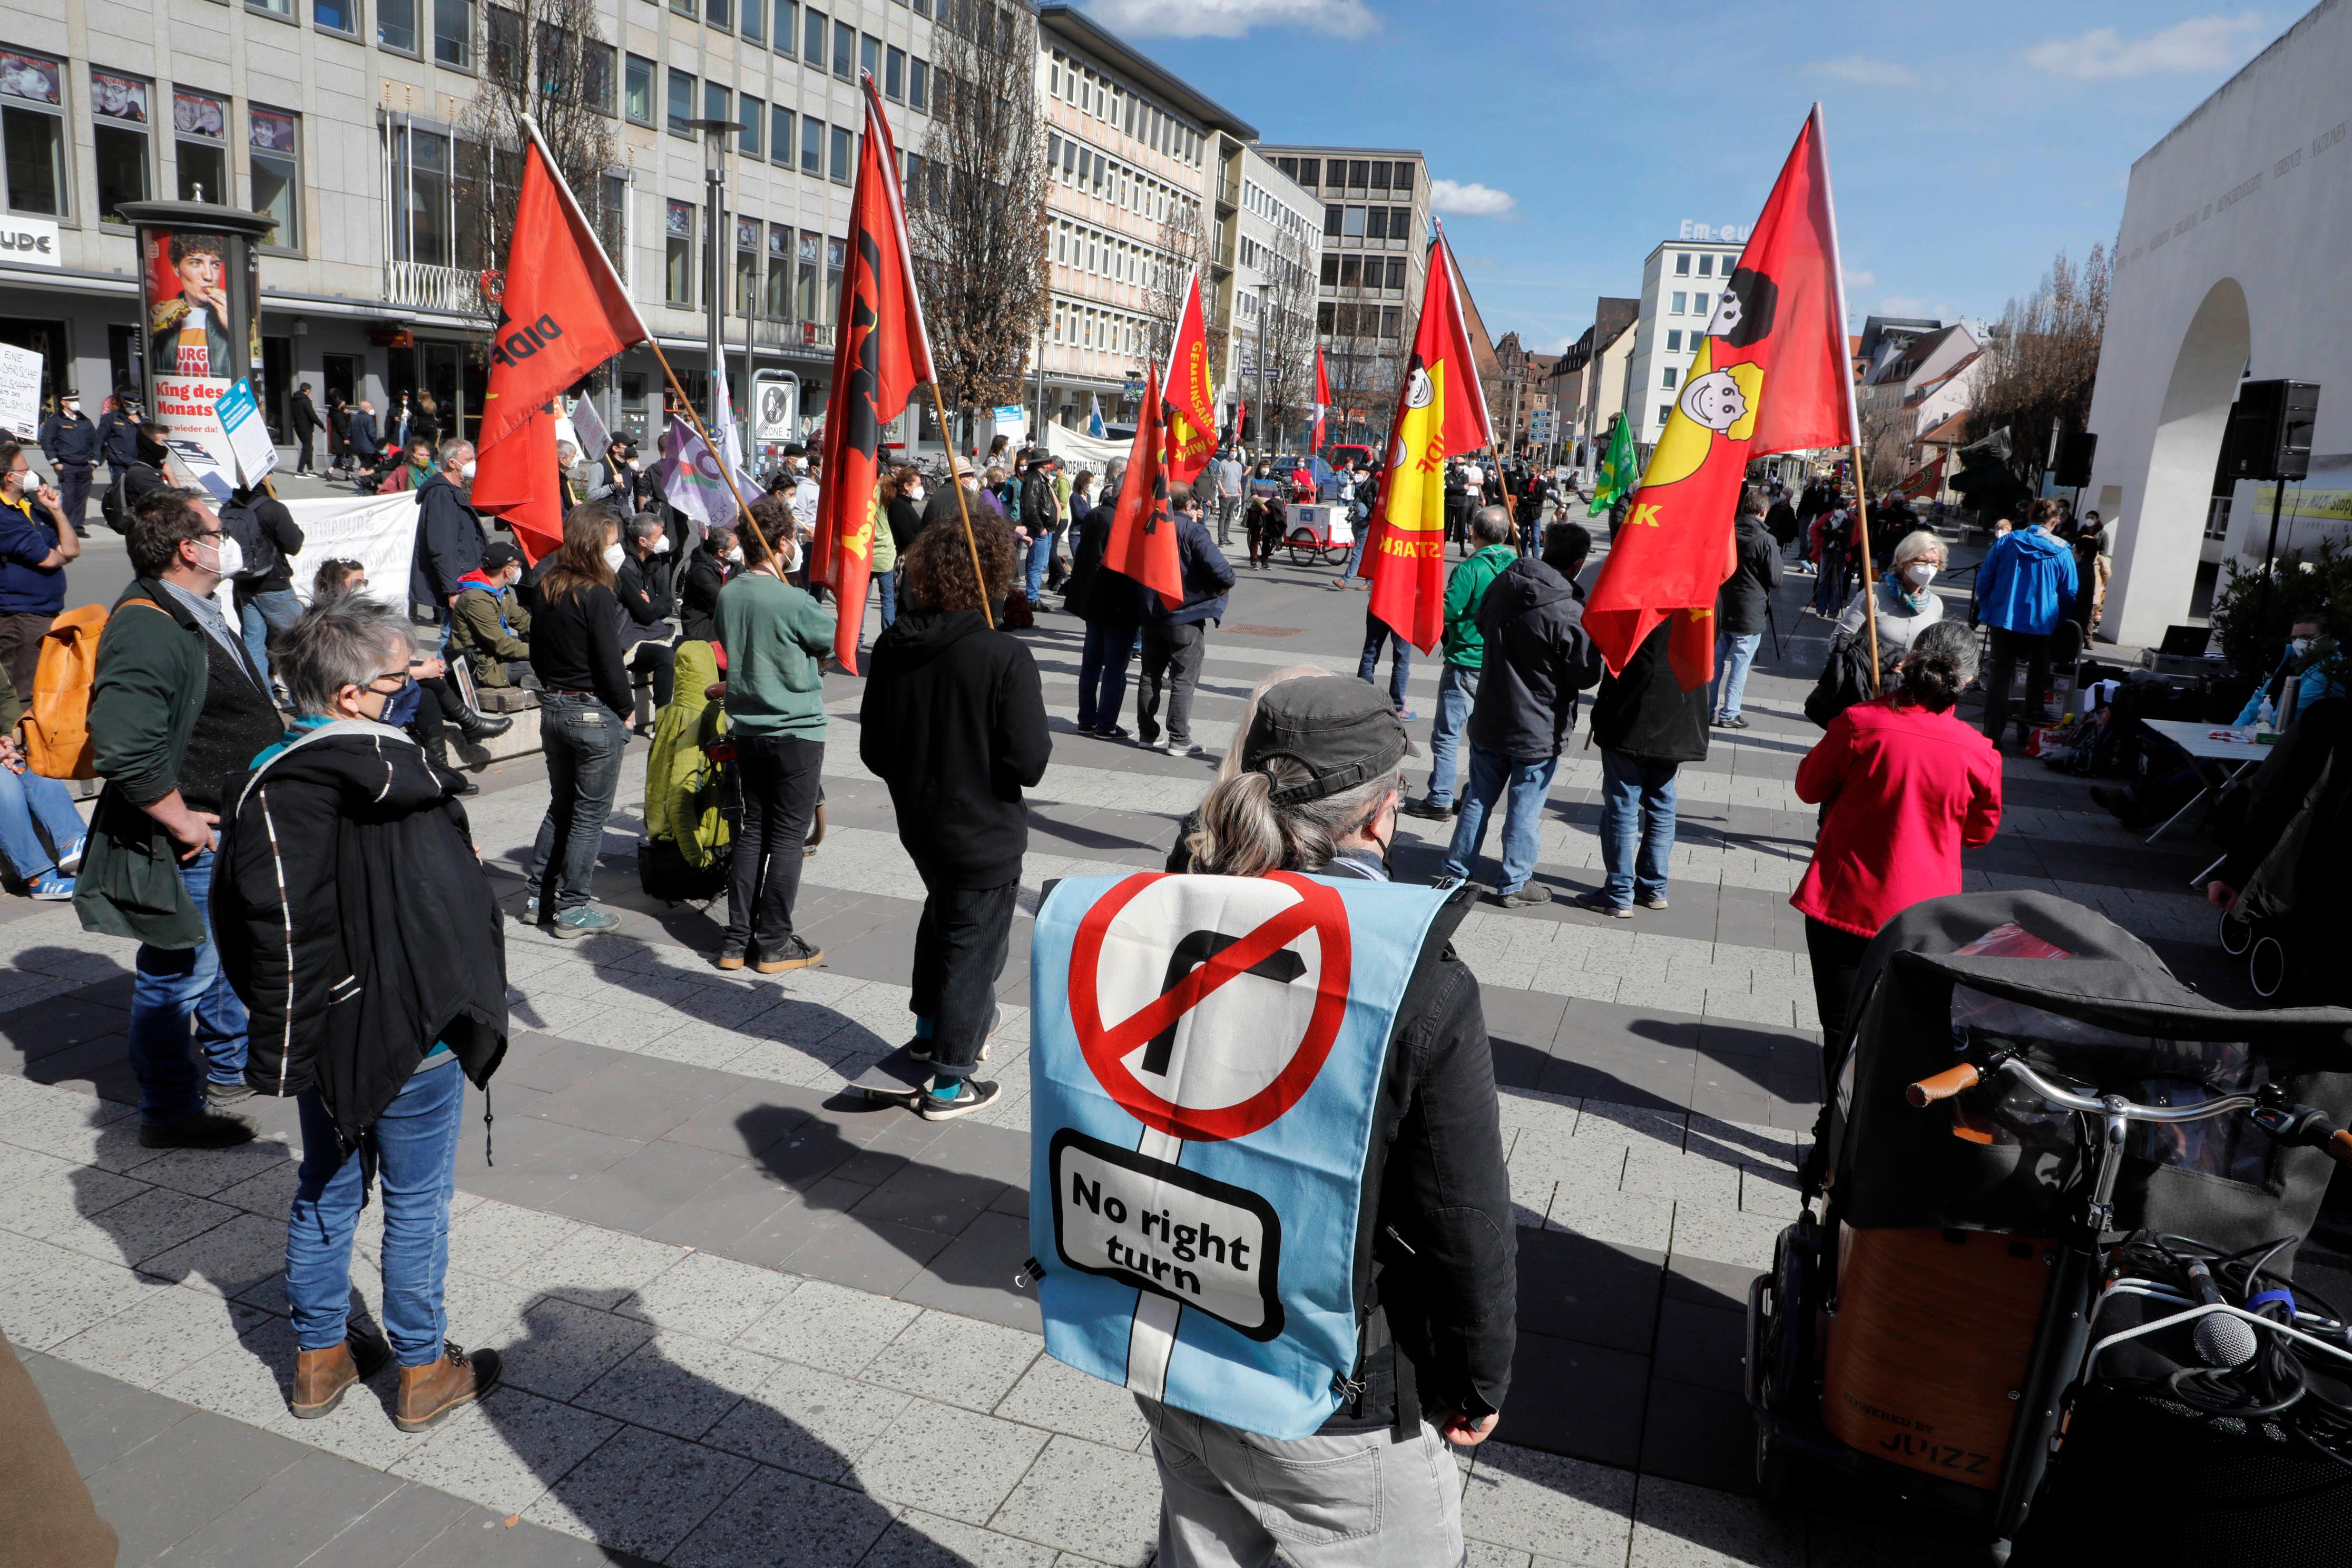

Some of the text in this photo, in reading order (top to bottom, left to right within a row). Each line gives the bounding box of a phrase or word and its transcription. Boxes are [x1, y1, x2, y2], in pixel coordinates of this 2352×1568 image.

[1680, 219, 1757, 241] Em-eu
[156, 381, 224, 401] King des
[1190, 341, 1213, 427] GEMEINSAM
[158, 401, 213, 416] Monats
[765, 427, 783, 436] ZONE
[1073, 1171, 1250, 1271] No right
[1106, 1235, 1201, 1295] turn
[1842, 1391, 1935, 1434] POWERED BY
